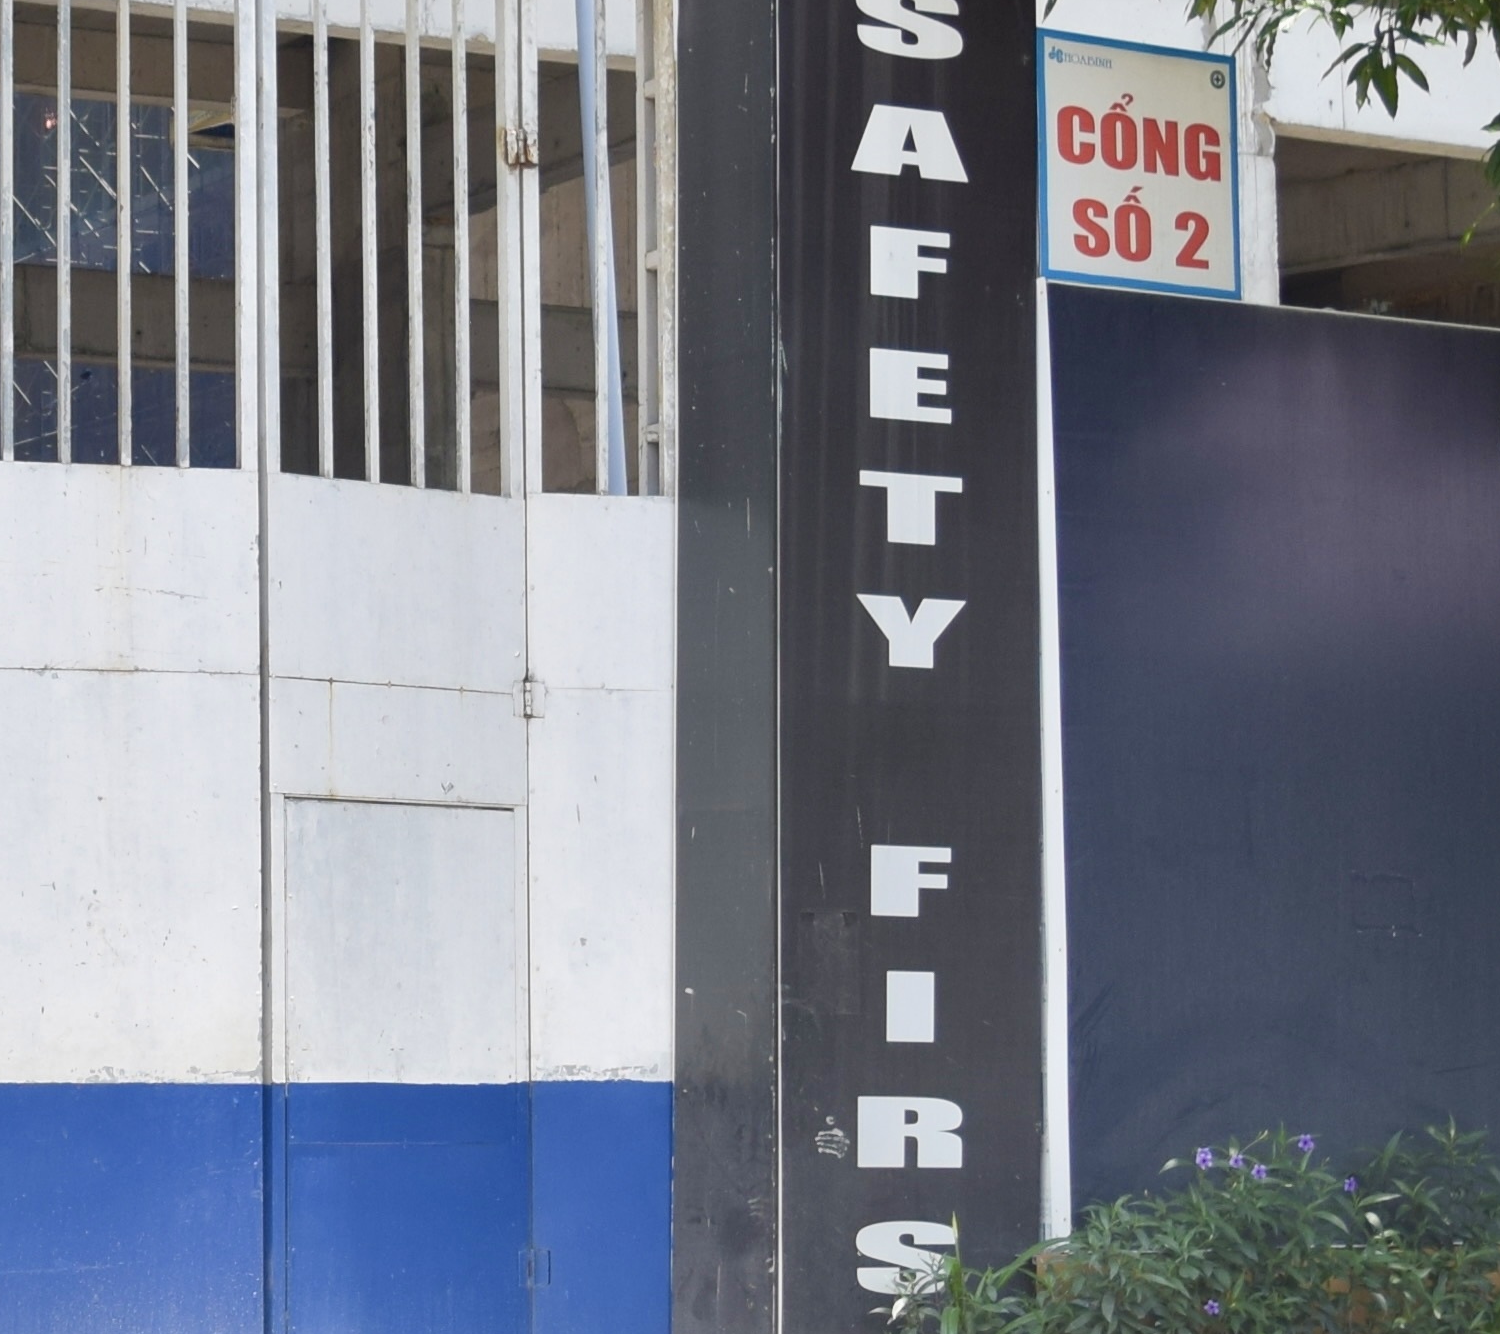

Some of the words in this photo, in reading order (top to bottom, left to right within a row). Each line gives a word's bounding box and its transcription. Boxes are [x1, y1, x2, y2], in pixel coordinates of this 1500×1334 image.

[1056, 92, 1222, 183] CỔNG
[1072, 186, 1152, 263] SỐ
[1174, 211, 1210, 270] 2
